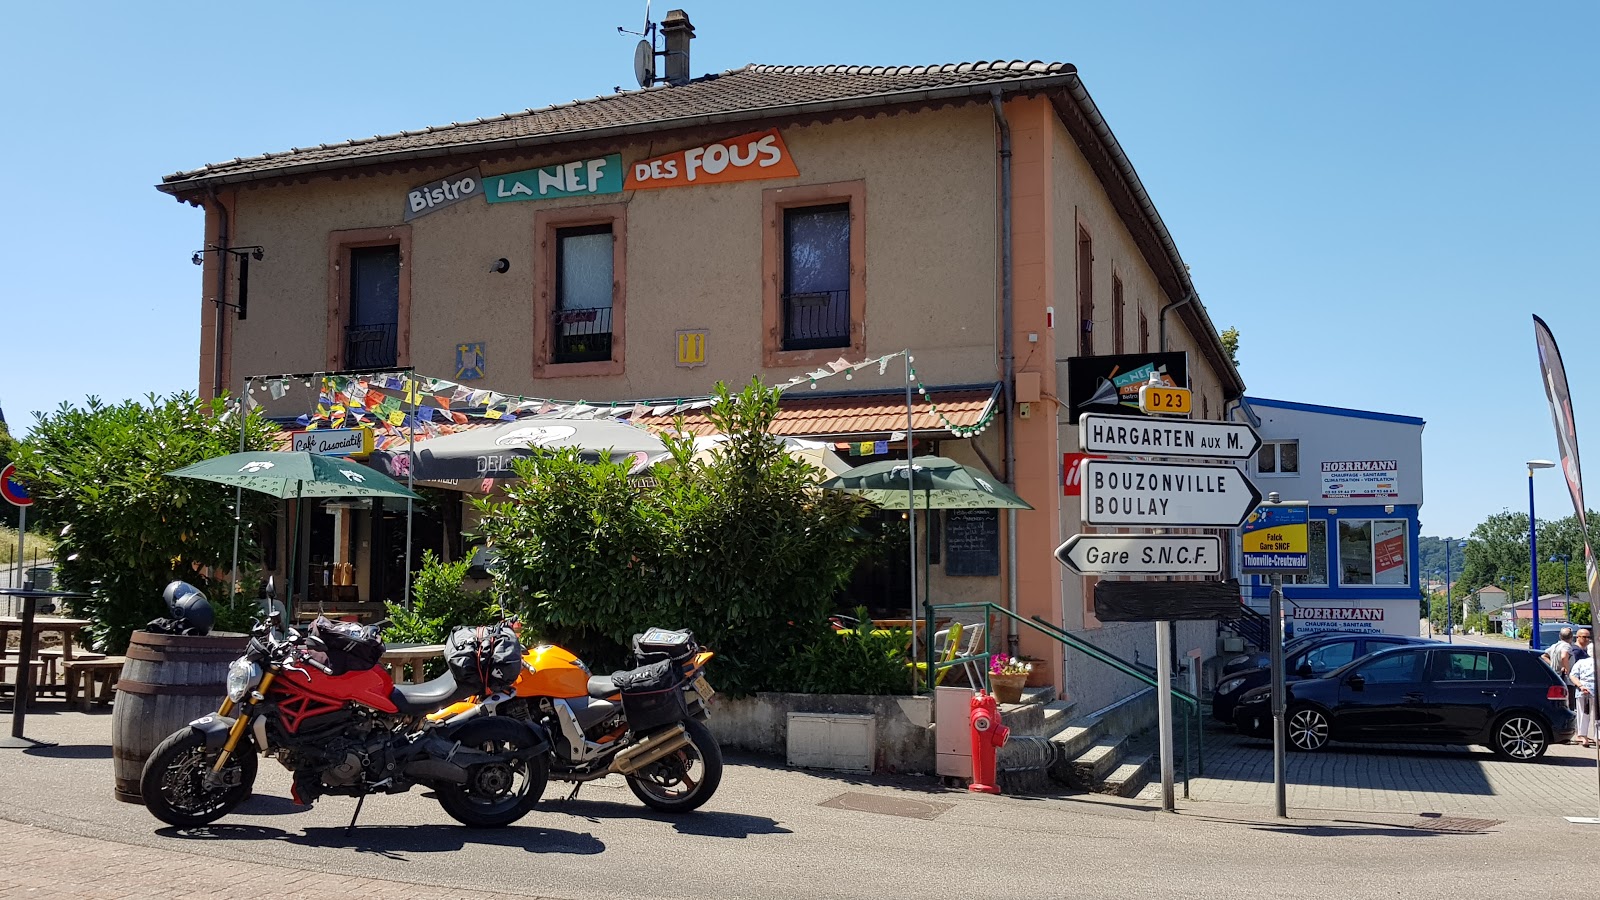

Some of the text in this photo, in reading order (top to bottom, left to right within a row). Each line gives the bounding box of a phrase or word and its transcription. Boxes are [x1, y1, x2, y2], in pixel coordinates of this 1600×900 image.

[410, 134, 782, 213] Bistro LA NEF DES FOUS
[1153, 393, 1183, 408] D 23
[295, 432, 362, 453] Café Associatif
[1093, 424, 1244, 450] HARGARTEN AUX M.
[1323, 461, 1396, 471] HOERRMANN
[1095, 471, 1226, 493] BOUZONVILLE
[1095, 497, 1169, 515] BOULAY
[1266, 533, 1283, 541] Falck
[1259, 542, 1291, 550] Gare SNCF
[1086, 546, 1207, 564] Gare S.N.C.F.
[1243, 554, 1307, 567] Thionville-Creutzwald
[1294, 608, 1383, 620] HOERRMANN
